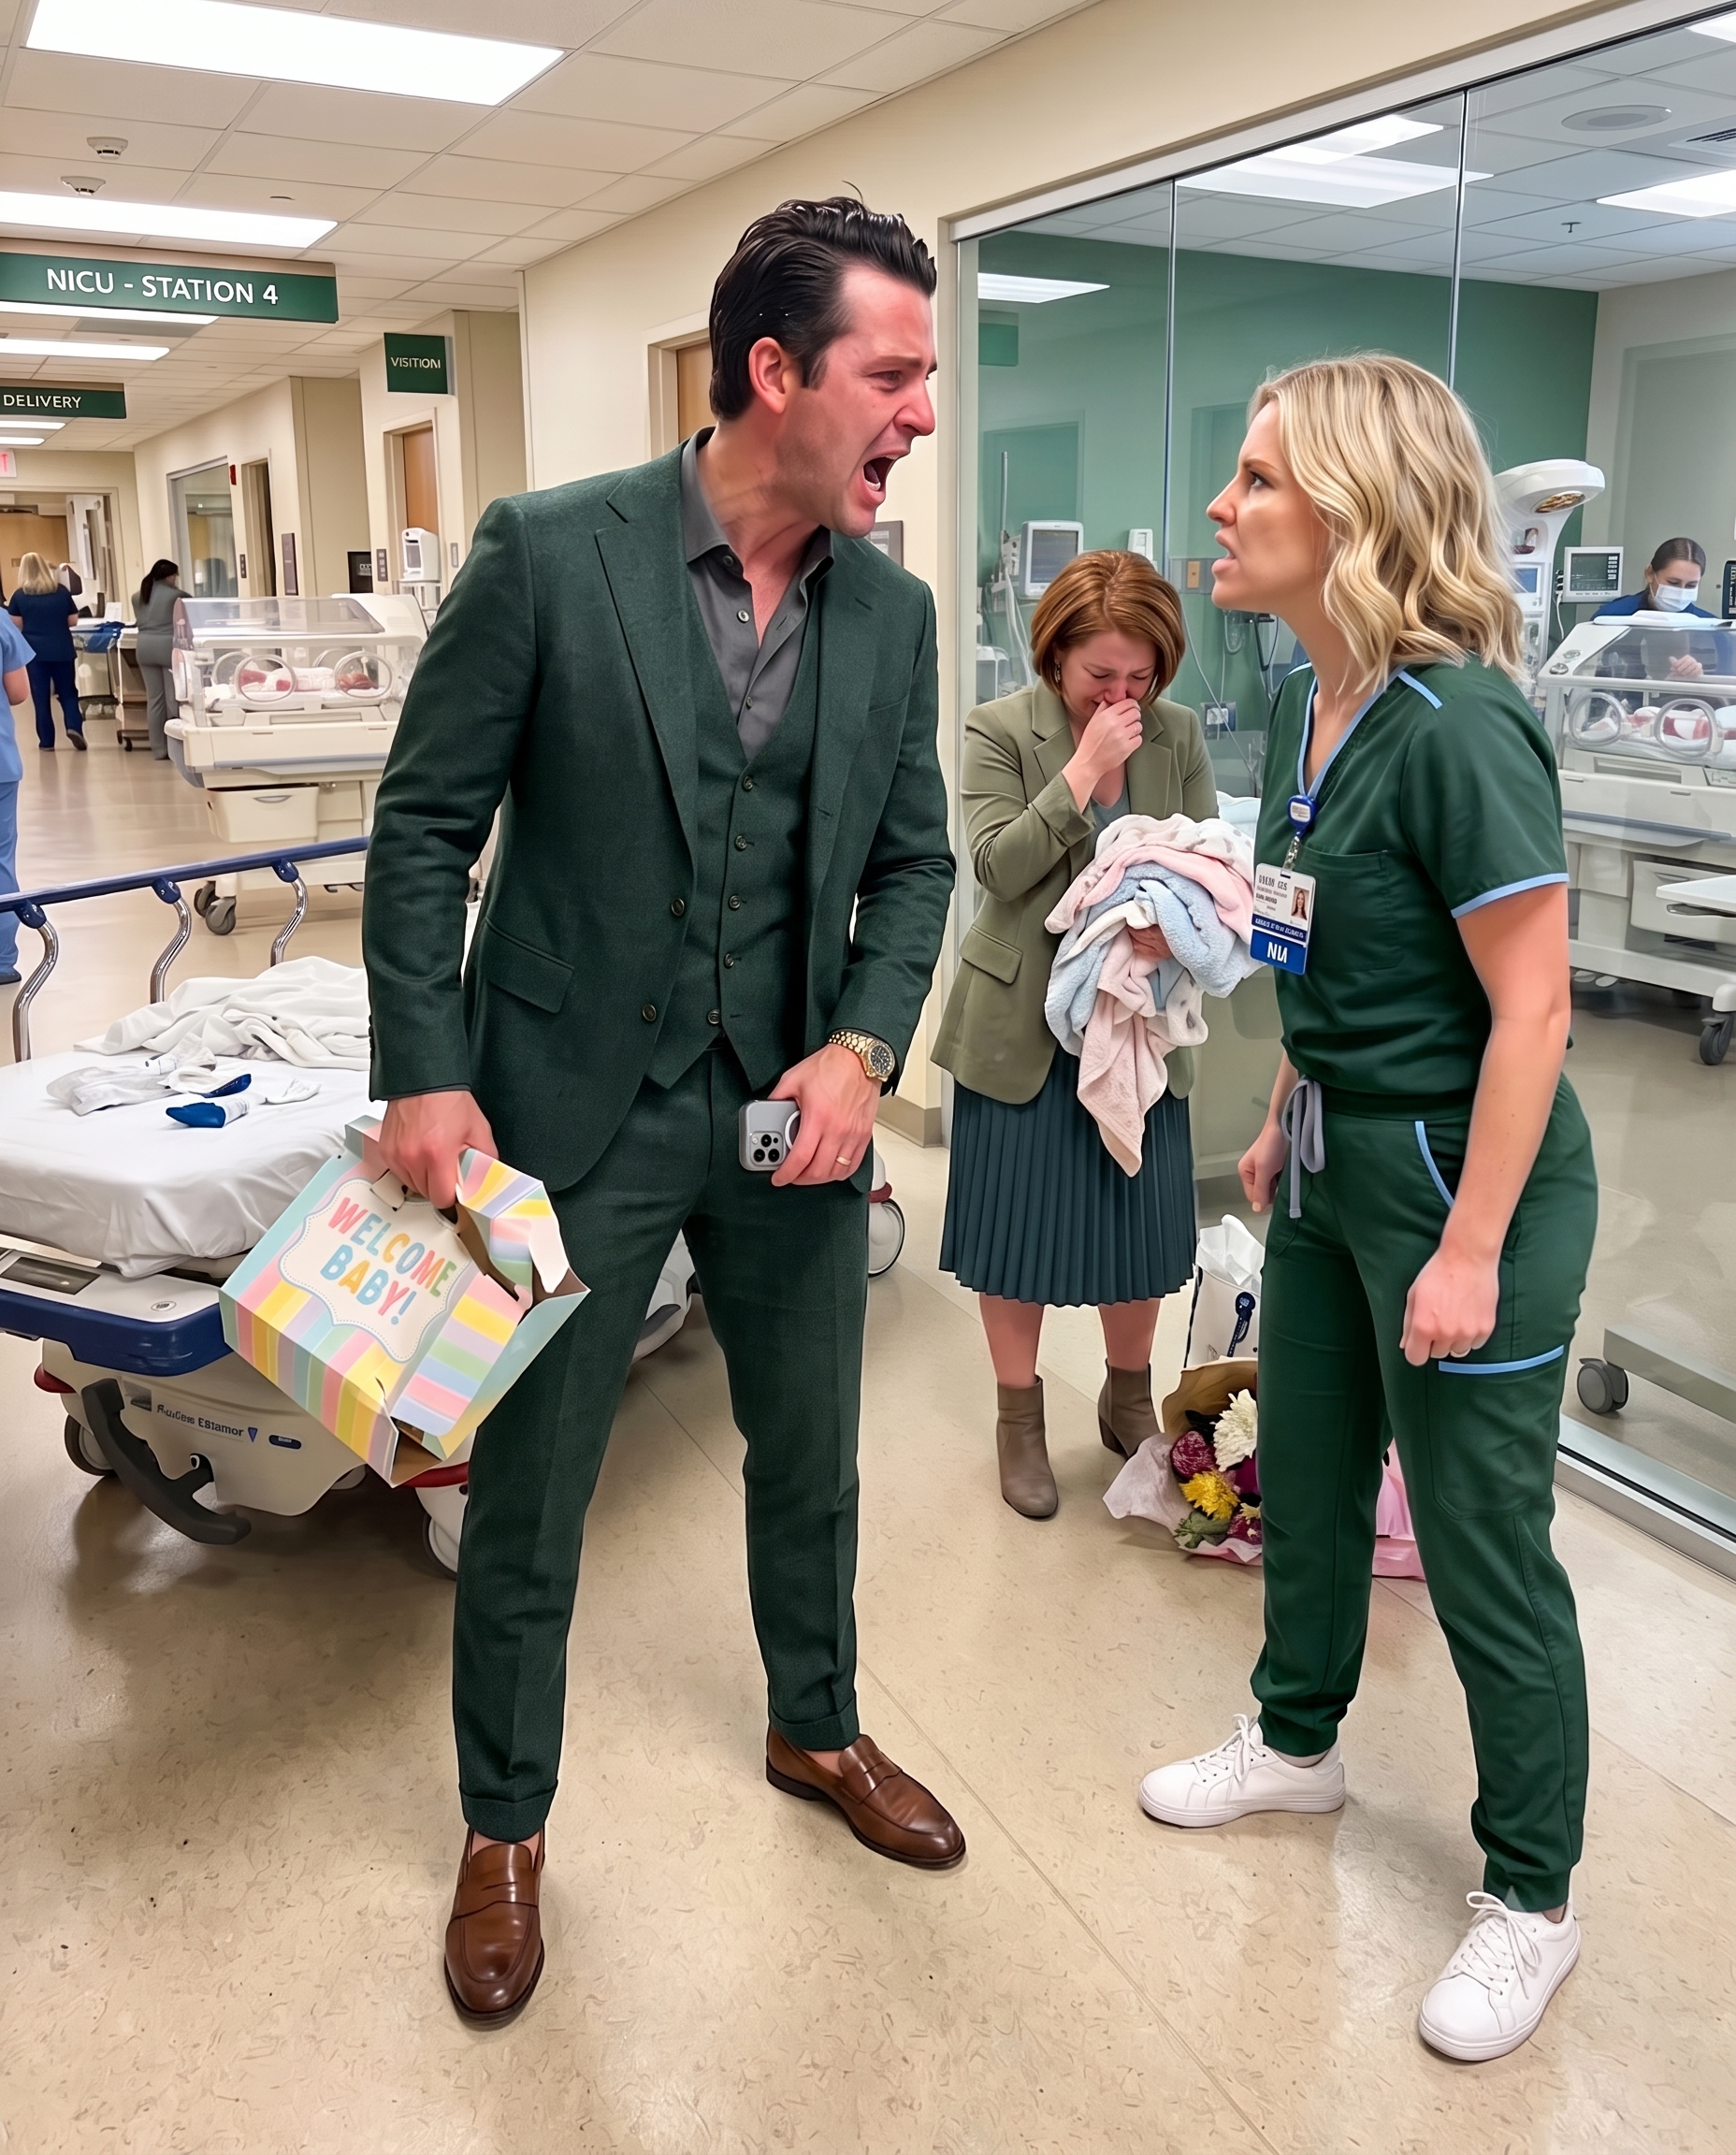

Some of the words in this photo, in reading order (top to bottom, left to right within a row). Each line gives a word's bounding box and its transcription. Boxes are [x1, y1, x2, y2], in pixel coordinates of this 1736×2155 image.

[47, 268, 114, 294] NICU
[141, 275, 253, 304] STATION
[262, 284, 279, 305] 4
[390, 356, 441, 369] VISITION
[3, 394, 81, 409] DELIVERY
[328, 1197, 457, 1297] WELCOME
[320, 1244, 417, 1325] BABY!
